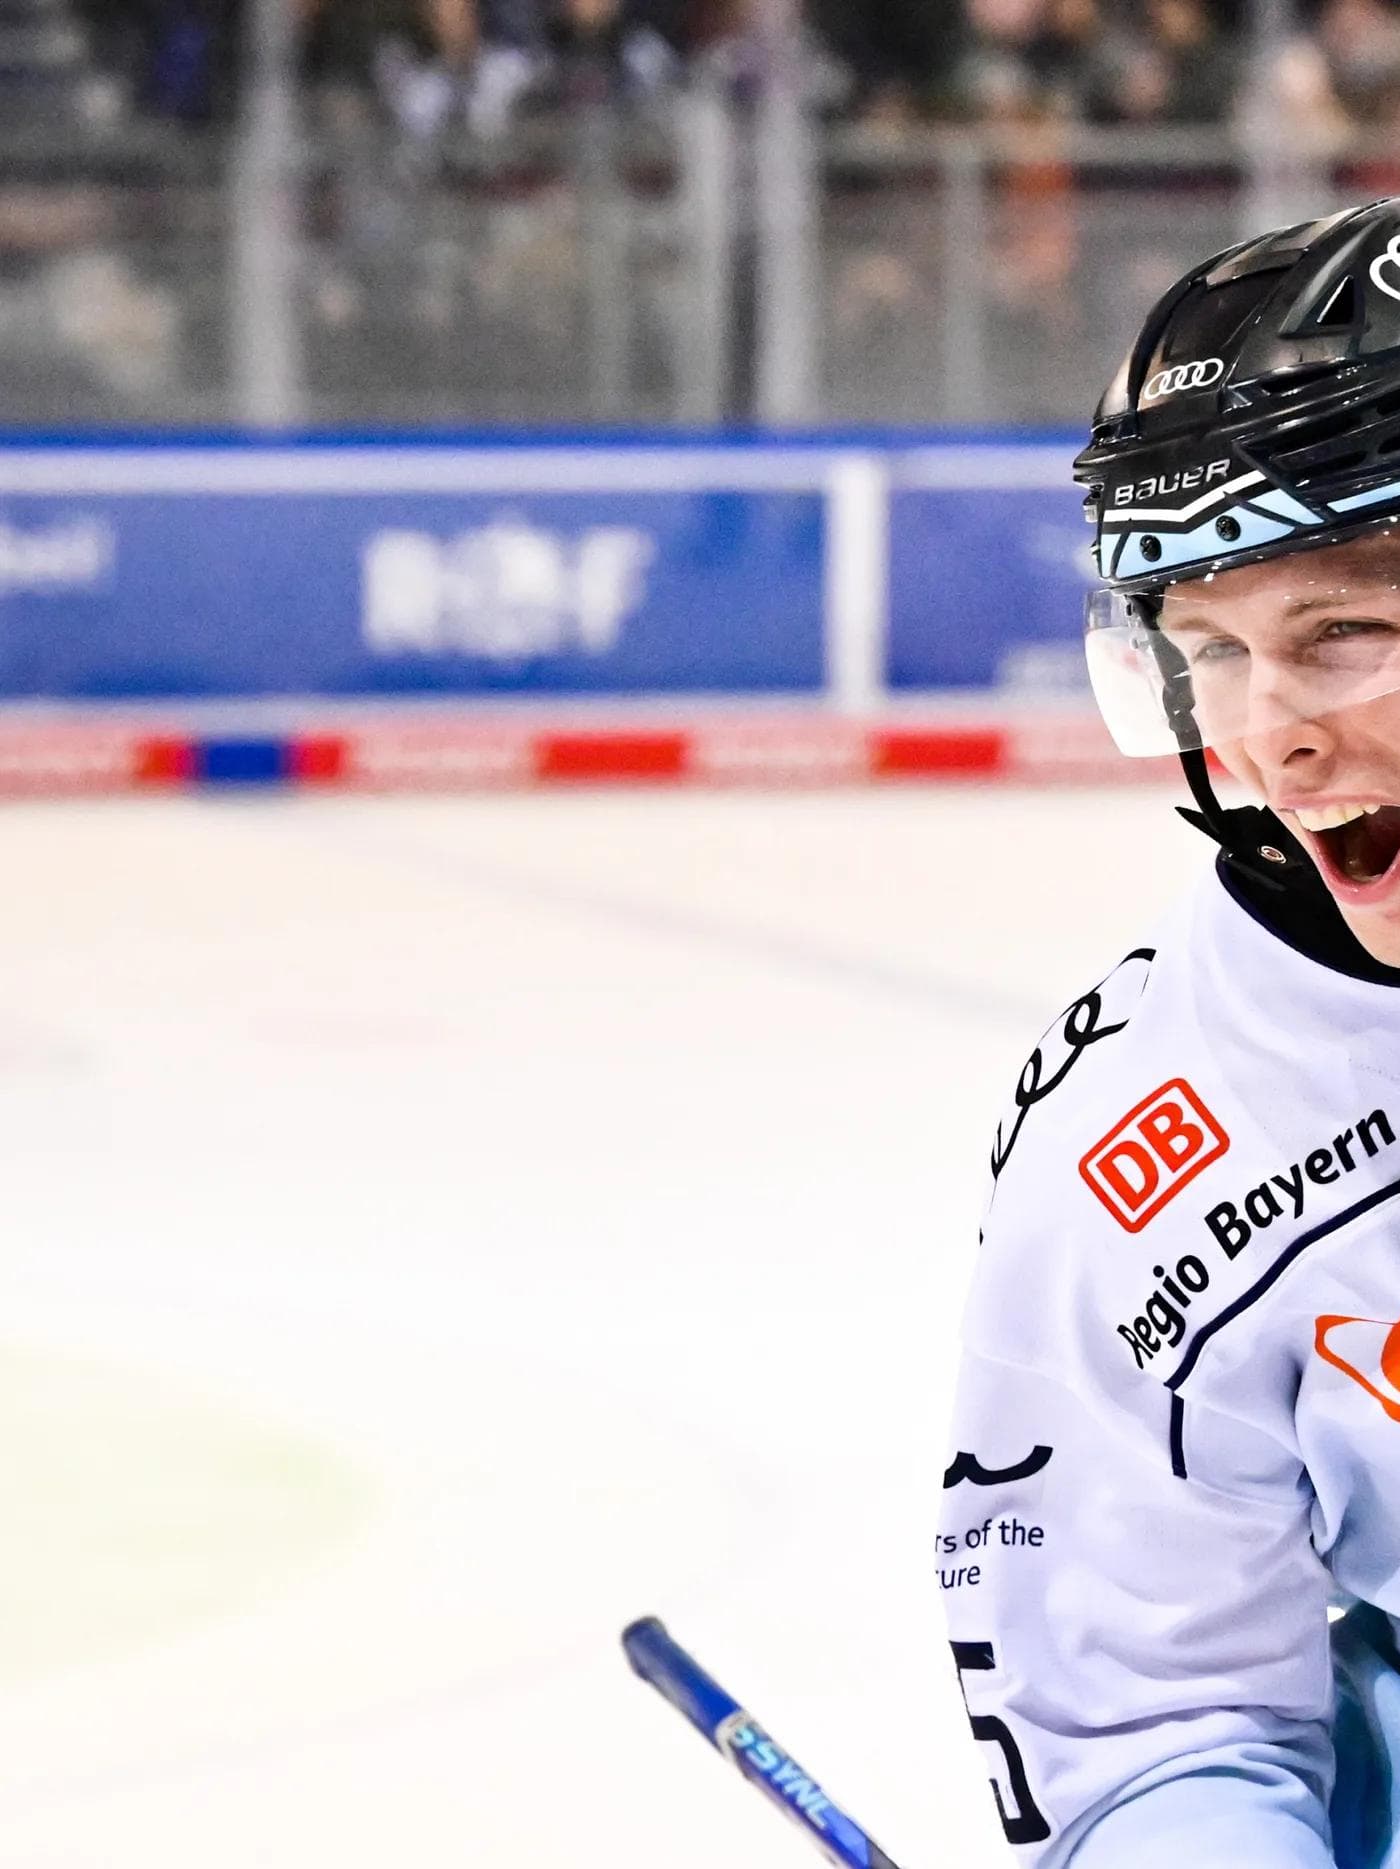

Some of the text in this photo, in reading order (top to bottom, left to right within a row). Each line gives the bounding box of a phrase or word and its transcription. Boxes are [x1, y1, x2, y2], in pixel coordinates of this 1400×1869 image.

[1114, 458, 1231, 506] BAUER
[1095, 1101, 1205, 1212] DB
[1116, 1108, 1397, 1370] Regio Bayern
[964, 1518, 993, 1549] of
[998, 1518, 1045, 1547] the
[936, 1565, 981, 1590] ure
